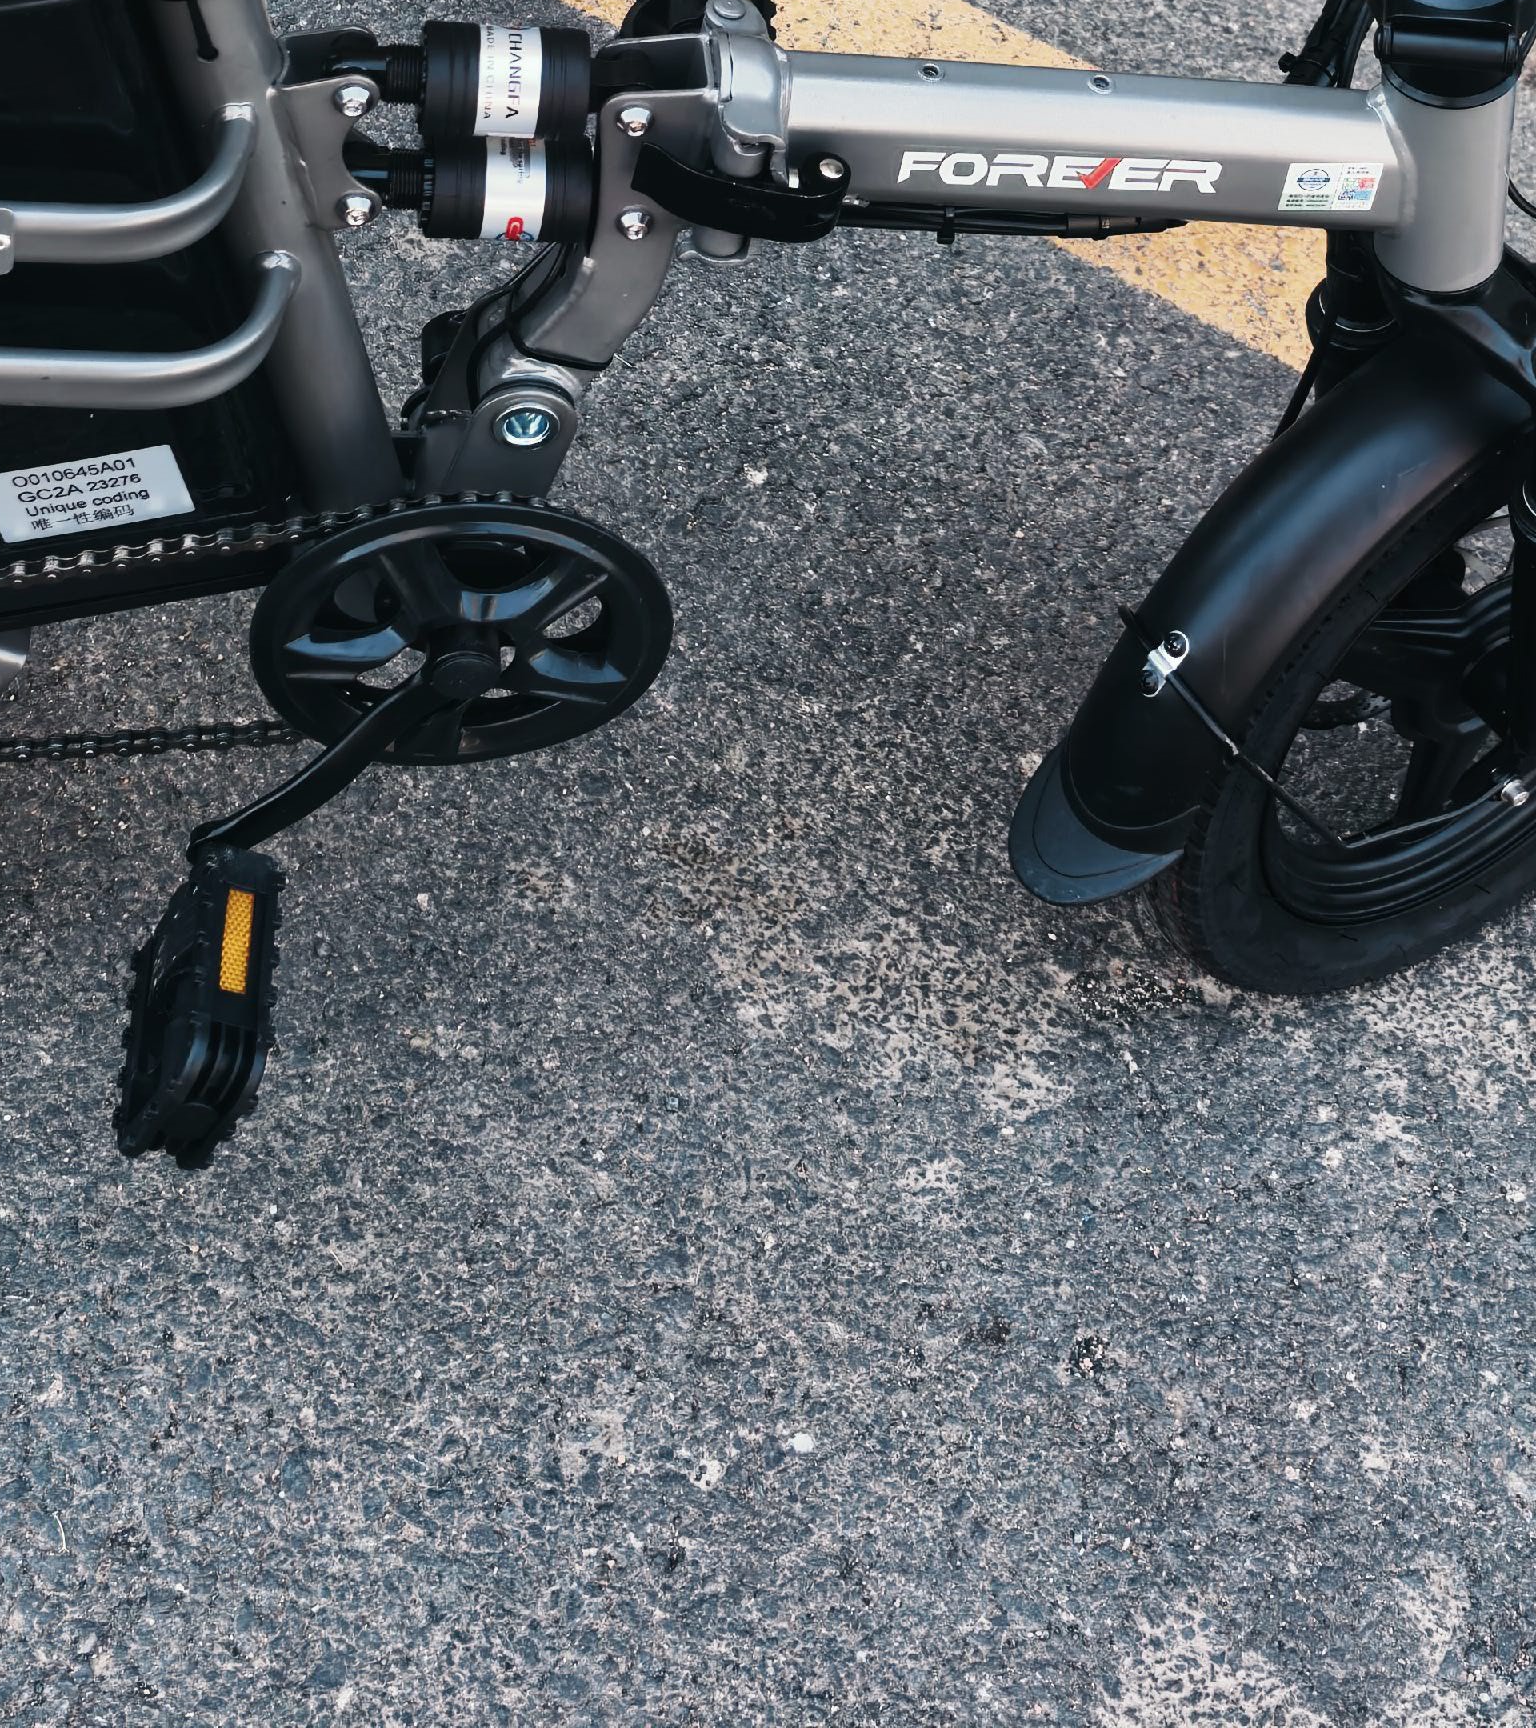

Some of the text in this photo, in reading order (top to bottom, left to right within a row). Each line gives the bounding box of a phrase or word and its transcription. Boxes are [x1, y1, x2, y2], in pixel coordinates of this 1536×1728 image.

[505, 33, 523, 119] CHANGFA
[18, 473, 142, 503] GC2A 23276
[25, 488, 151, 517] Unique coding
[31, 504, 135, 531] 唯一性编码
